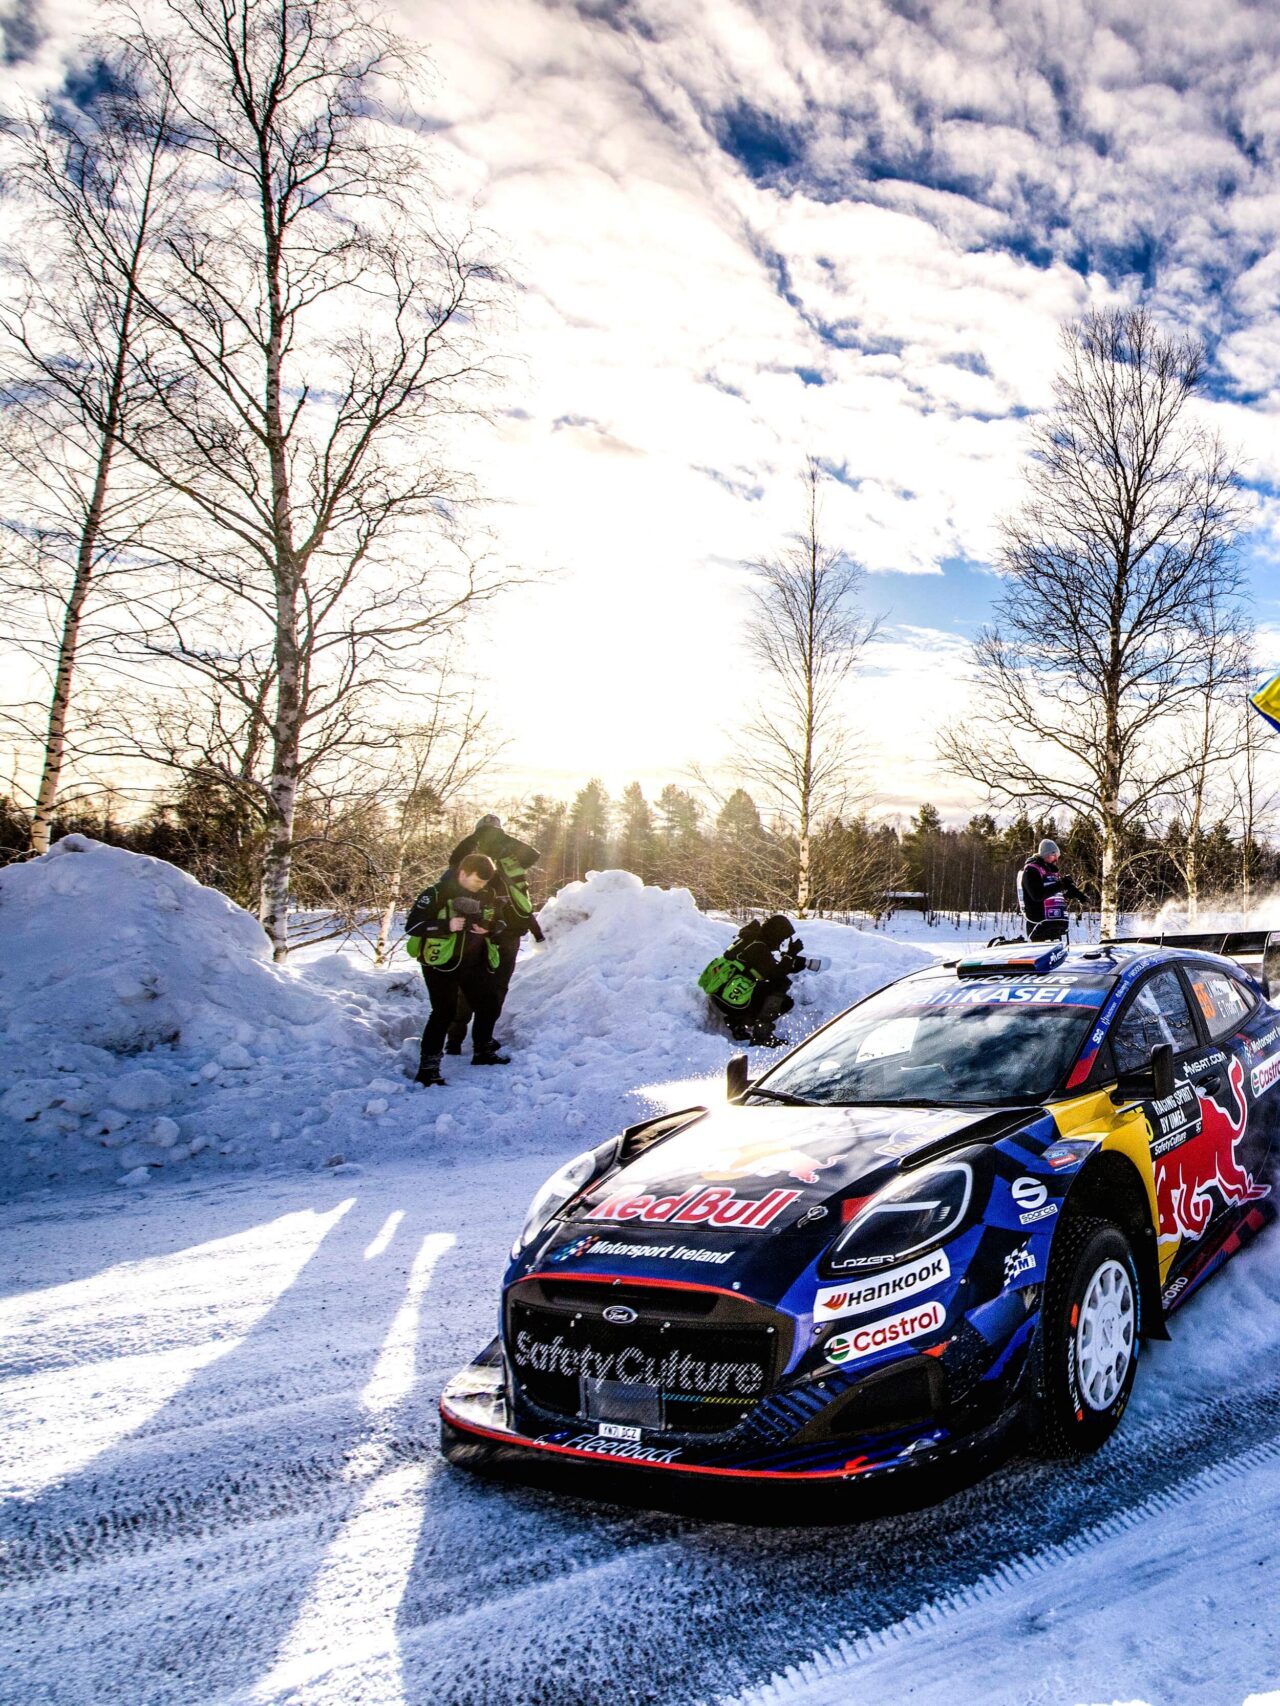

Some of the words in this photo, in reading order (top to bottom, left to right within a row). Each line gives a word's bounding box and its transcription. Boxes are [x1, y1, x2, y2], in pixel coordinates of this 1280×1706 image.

[1151, 1095, 1177, 1116] RACING
[1173, 1085, 1194, 1106] SPIRIT
[1159, 1115, 1170, 1134] BY
[1154, 1131, 1187, 1156] SafetyCulture
[672, 1186, 802, 1229] Bull
[586, 1240, 674, 1258] Motorsport
[672, 1247, 735, 1264] Ireland
[853, 1305, 939, 1352] Castrol
[514, 1329, 764, 1395] SafetyCulture
[561, 1433, 684, 1464] Fleetback
